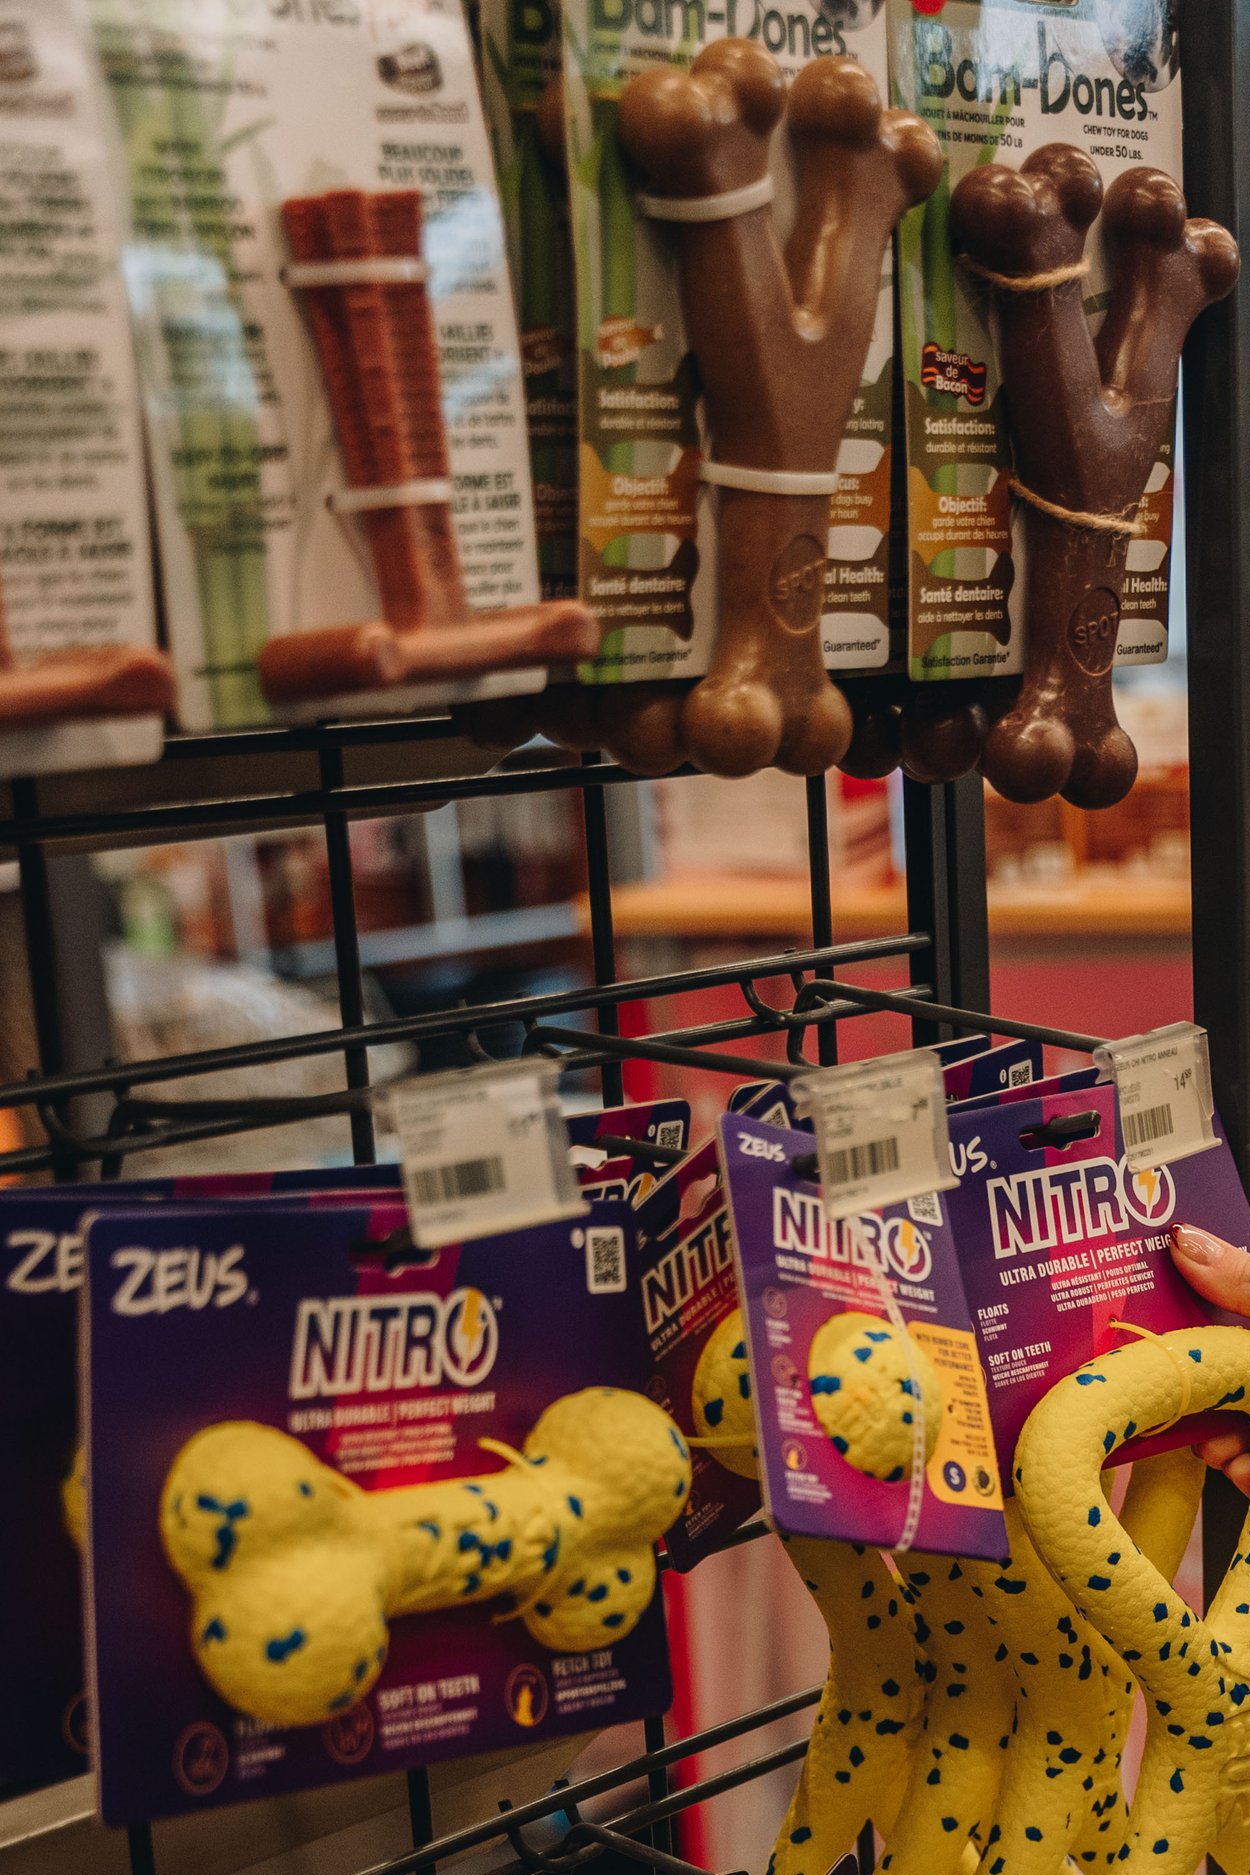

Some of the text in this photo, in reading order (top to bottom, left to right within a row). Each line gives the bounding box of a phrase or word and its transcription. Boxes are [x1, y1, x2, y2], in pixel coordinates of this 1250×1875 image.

[953, 110, 1005, 126] MÂCHOUILLER
[964, 133, 1012, 148] MOINS 50
[1083, 124, 1149, 141] CHEW DOGS
[1090, 145, 1128, 159] UNDER 50
[936, 351, 969, 366] saveur
[946, 366, 959, 378] de
[936, 376, 968, 394] Bacon
[925, 417, 996, 436] Satisfaction:
[613, 478, 669, 496] Objectif:
[939, 496, 987, 514] Objectif:
[840, 567, 884, 584] Health:
[591, 577, 685, 597] Santé dentaire:
[1133, 577, 1168, 593] Health:
[921, 586, 1004, 604] Santé dentaire:
[737, 1132, 786, 1162] ZEUS
[986, 1156, 1176, 1260] NITRO
[773, 1186, 932, 1283] NITRO
[6, 1231, 83, 1292] ZE
[1000, 1239, 1144, 1286] ULTRA DURABLE PERFECT
[111, 1246, 248, 1316] ZEUS
[978, 1303, 1010, 1321] FLOATS
[289, 1286, 500, 1398] NITRO
[988, 1341, 1051, 1367] SOFT ON TEETH
[288, 1408, 332, 1432] ULTRA
[333, 1402, 388, 1427] DURABLE
[453, 1391, 496, 1415] WEIGHT
